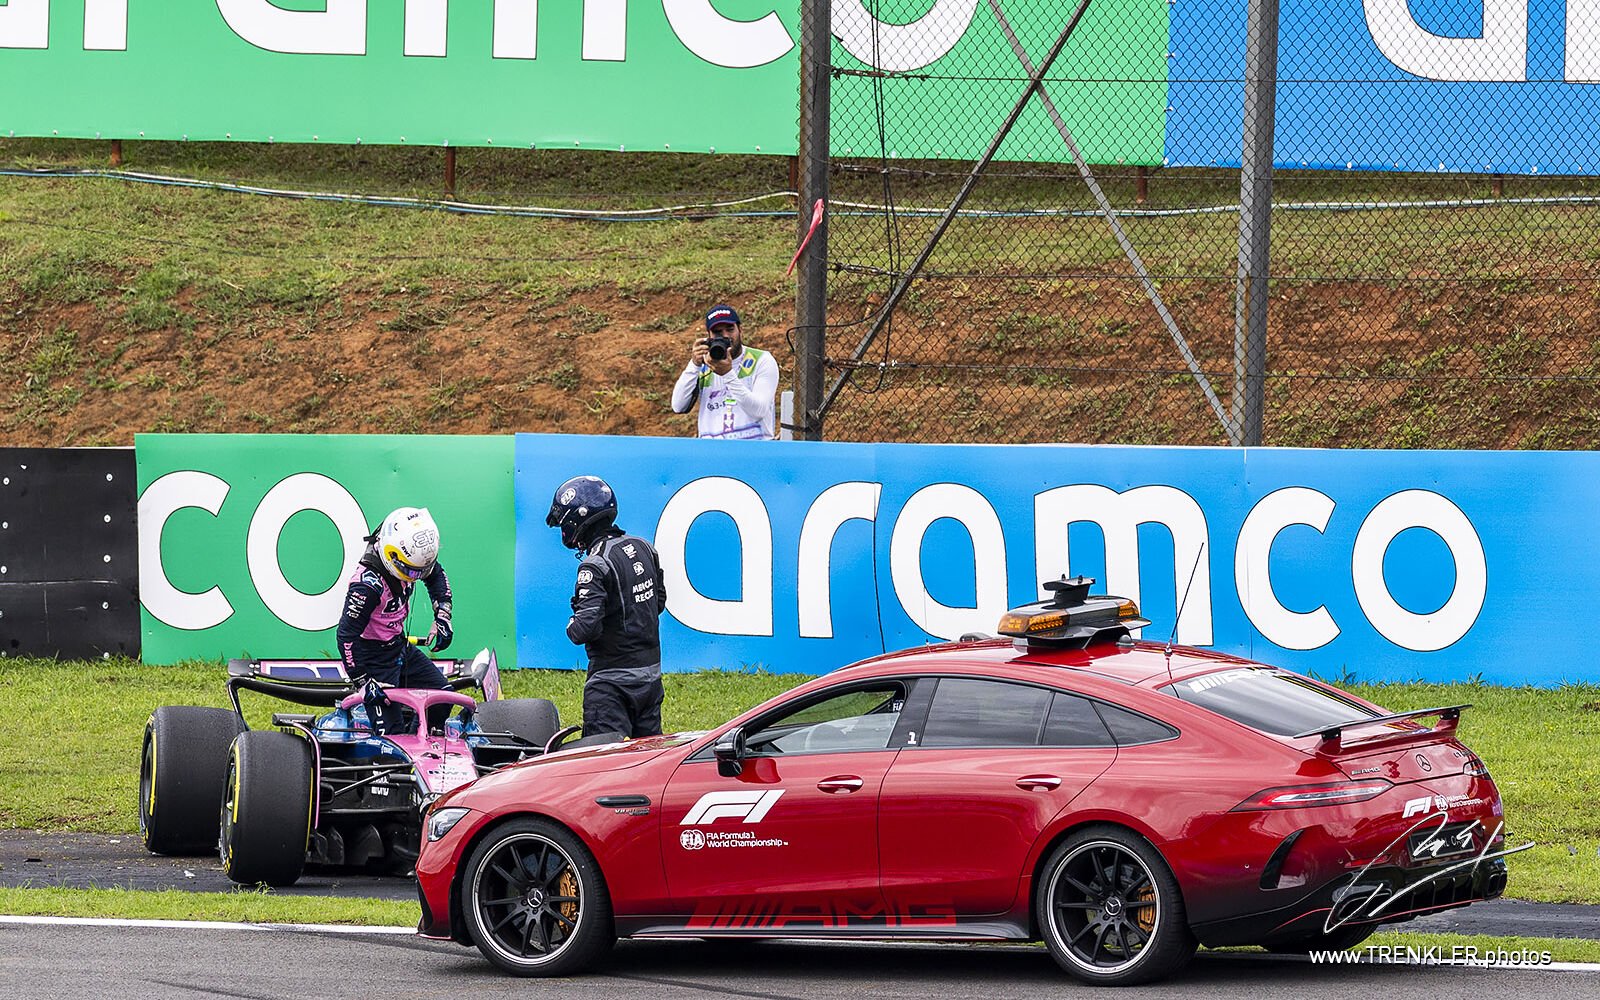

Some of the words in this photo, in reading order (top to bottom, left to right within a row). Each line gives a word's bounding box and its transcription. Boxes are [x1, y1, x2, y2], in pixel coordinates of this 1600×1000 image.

[137, 470, 370, 632] co
[653, 475, 1488, 652] aramco
[907, 731, 917, 745] 1
[679, 789, 786, 825] F1
[1402, 796, 1432, 818] F1
[681, 832, 704, 847] FIA
[706, 832, 719, 840] FIA
[719, 831, 750, 840] Formula
[751, 831, 756, 839] 1
[706, 840, 729, 848] World
[776, 901, 956, 928] AMG
